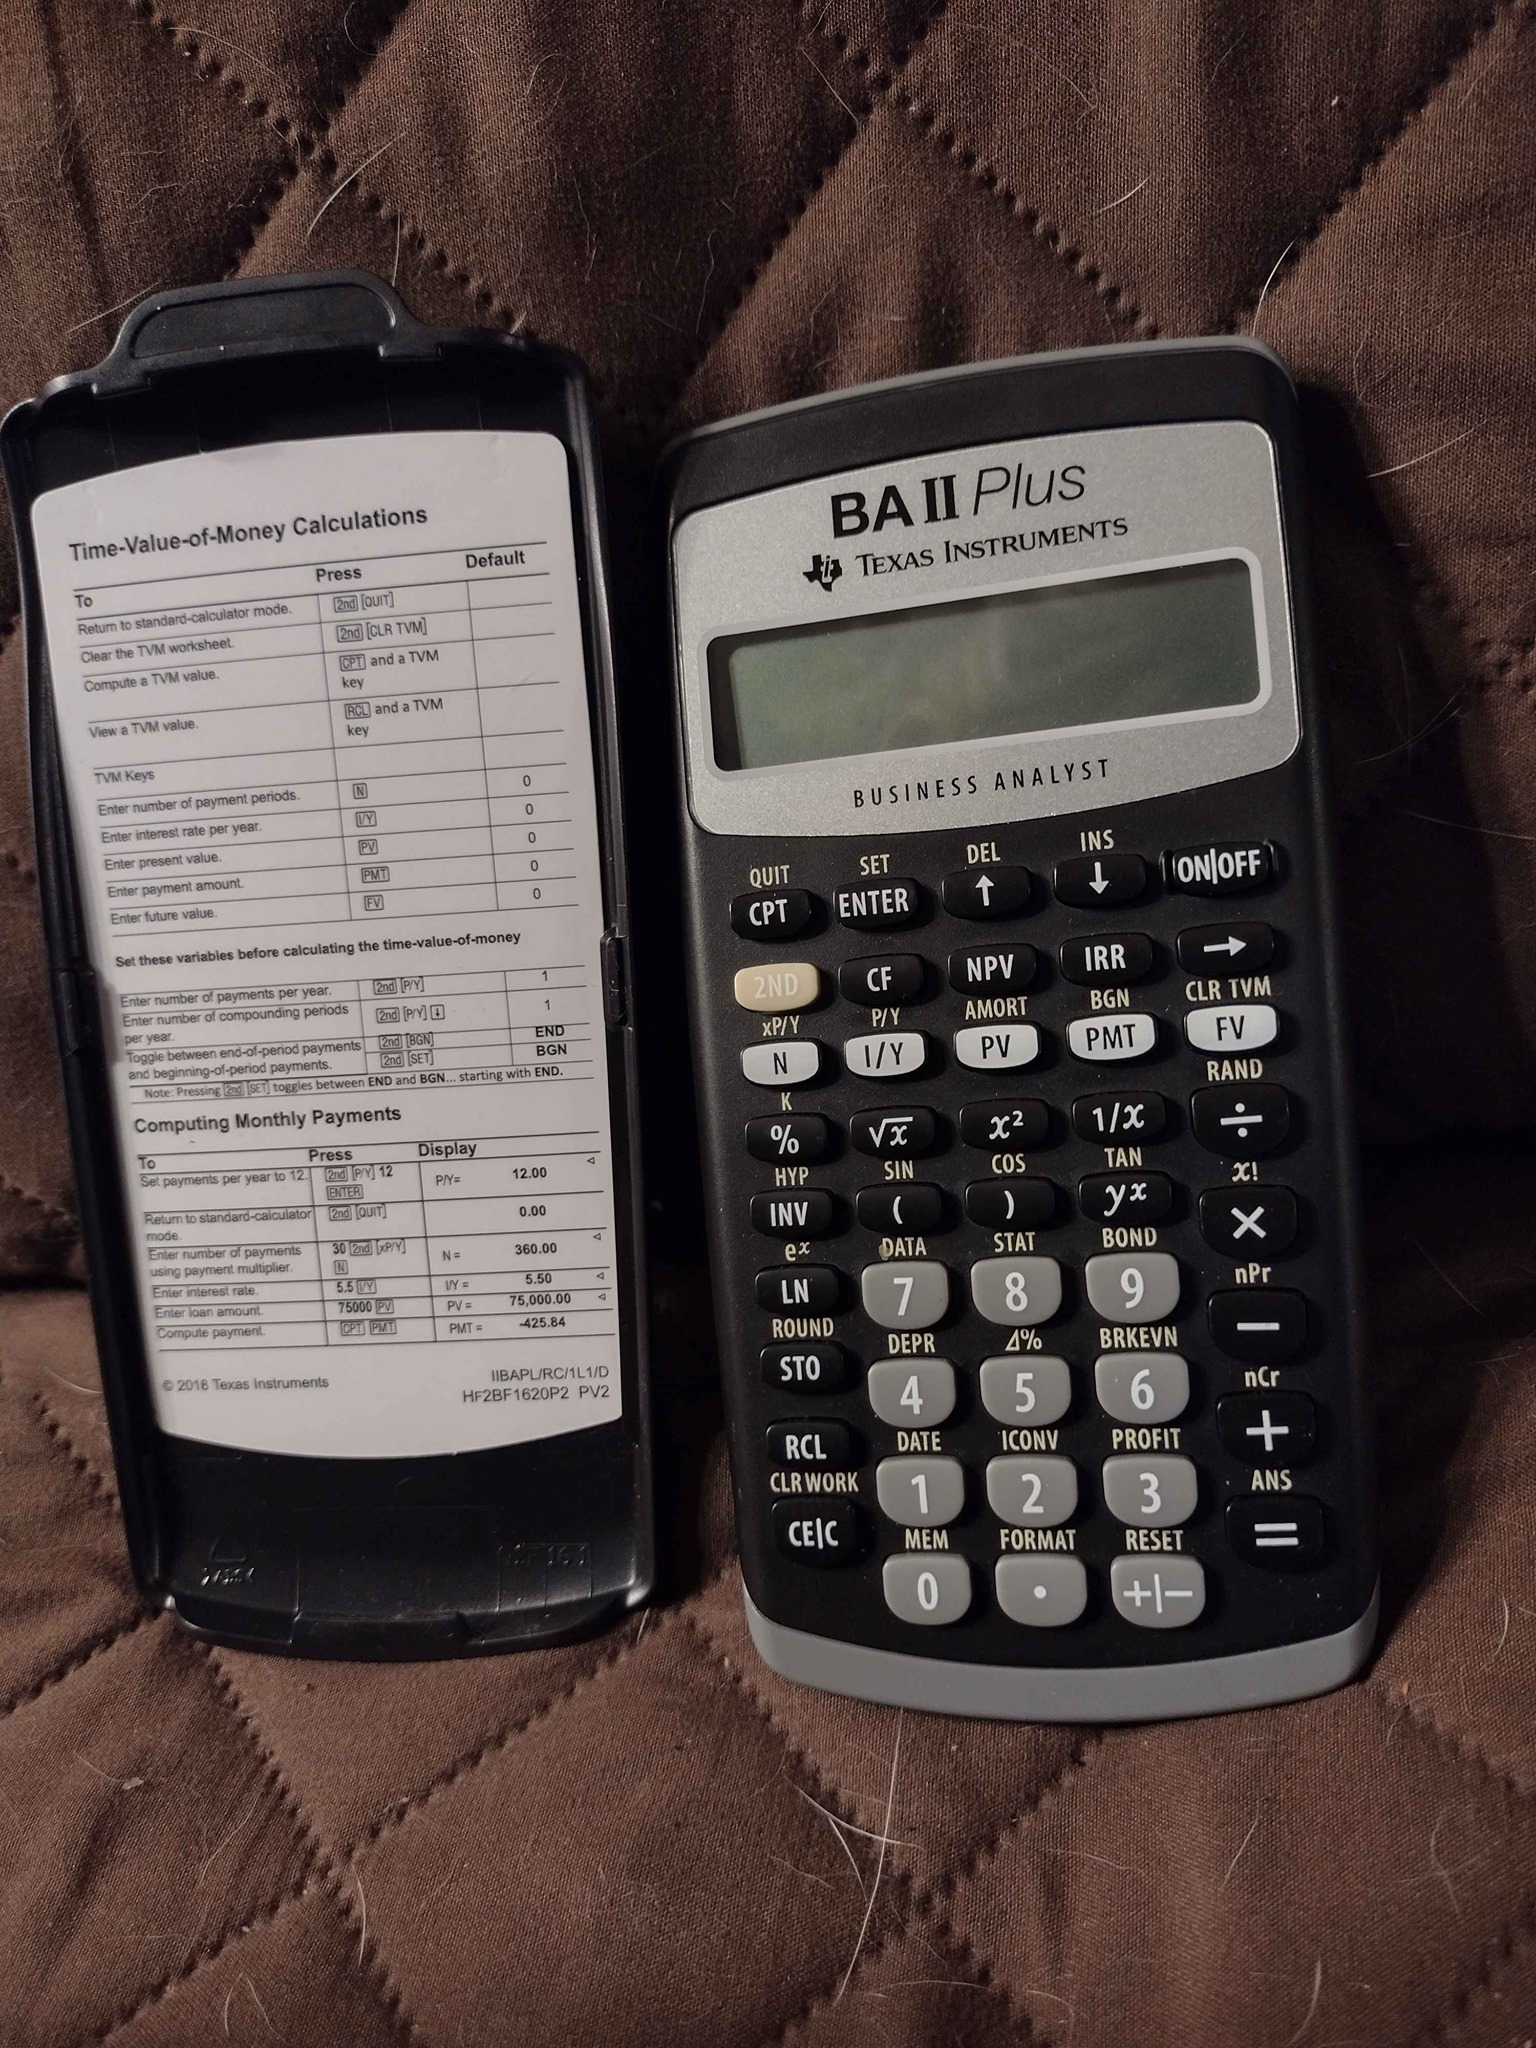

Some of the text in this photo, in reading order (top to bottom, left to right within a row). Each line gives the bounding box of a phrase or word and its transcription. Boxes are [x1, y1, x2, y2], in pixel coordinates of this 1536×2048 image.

[830, 462, 1086, 539] BA II Plus
[69, 508, 428, 562] Time-Value-of-Money Calculations
[465, 550, 526, 569] Default
[315, 567, 362, 583] Press
[74, 594, 93, 608] To
[78, 603, 292, 636] Return to standard-calculator mode.
[80, 638, 235, 664] Clear the TVM worksheet.
[84, 669, 220, 694] Compute a TVM value.
[89, 718, 199, 739] View a TVM value.
[94, 770, 155, 784] TVM Keys
[523, 774, 531, 787] 0
[853, 758, 1108, 808] BUSINESS ANALYST
[99, 790, 300, 816] Enter number of payment periods.
[525, 803, 534, 815] 0
[101, 821, 263, 844] Enter interest rate per year.
[528, 832, 536, 843] 0
[1080, 829, 1115, 851] INS
[104, 852, 222, 871] Enter present value.
[859, 853, 890, 875] SET
[967, 842, 1001, 864] DEL
[531, 860, 539, 872] 0
[750, 865, 790, 888] QUIT
[107, 878, 244, 898] Enter payment amount.
[533, 888, 541, 899] 0
[749, 899, 788, 926] CPT
[838, 887, 909, 918] ENTER
[111, 907, 217, 925] Enter future value.
[116, 931, 521, 968] Set these variables before calculating the time-value-of-money
[1085, 944, 1126, 971] IRR
[866, 966, 892, 992] CF
[966, 954, 1014, 982] NPV
[120, 985, 332, 1008] Enter number of payments per year.
[754, 973, 798, 999] 2ND
[1185, 975, 1272, 1002] CLR TVM
[965, 996, 1028, 1020] AMORT
[1090, 988, 1130, 1010] BGN
[762, 1015, 800, 1036] xP/Y
[872, 1007, 900, 1027] P/Y
[1216, 1015, 1245, 1041] FV
[535, 1025, 565, 1037] END
[1086, 1024, 1136, 1051] PMT
[536, 1044, 567, 1056] BGN
[864, 1042, 904, 1069] I/Y
[981, 1035, 1011, 1059] PV
[773, 1052, 788, 1075] N
[1207, 1058, 1263, 1082] RAND
[781, 1092, 793, 1111] K
[134, 1107, 402, 1136] Computing Monthly Payments
[309, 1148, 353, 1162] Press
[418, 1141, 477, 1158] Display
[1104, 1146, 1143, 1168] TAN
[138, 1156, 156, 1169] To
[512, 1167, 547, 1179] 12.00
[884, 1160, 914, 1180] SIN
[991, 1153, 1026, 1174] COS
[775, 1166, 809, 1186] HYP
[519, 1204, 547, 1217] 0.00
[770, 1201, 808, 1227] INV
[881, 1237, 927, 1258] DATA
[993, 1232, 1036, 1253] STAT
[1102, 1227, 1158, 1248] BOND
[514, 1243, 557, 1255] 360.00
[525, 1272, 552, 1285] 5.50
[1235, 1262, 1272, 1284] nPr
[781, 1278, 810, 1305] LN
[893, 1277, 914, 1316] 7
[1005, 1271, 1029, 1312] 8
[1120, 1267, 1145, 1309] 9
[338, 1301, 373, 1314] 75000
[510, 1292, 571, 1307] 75,000.00
[519, 1316, 566, 1329] -425.84
[772, 1317, 834, 1338] ROUND
[888, 1333, 936, 1354] DEPR
[1100, 1326, 1178, 1349] BRKEVN
[781, 1355, 821, 1381] STO
[1245, 1366, 1280, 1388] nCr
[213, 1376, 250, 1391] Texas
[254, 1375, 329, 1390] Instruments
[578, 1384, 610, 1399] PV2
[1015, 1372, 1036, 1414] 5
[1130, 1368, 1155, 1410] 6
[900, 1375, 923, 1414] 4
[785, 1434, 827, 1460] RCL
[897, 1430, 942, 1451] DATE
[1002, 1429, 1059, 1451] ICONV
[1112, 1428, 1181, 1449] PROFIT
[770, 1471, 859, 1493] CLR WORK
[1251, 1469, 1293, 1491] ANS
[911, 1474, 928, 1514] 1
[1021, 1473, 1044, 1514] 2
[1140, 1472, 1162, 1514] 3
[905, 1529, 949, 1550] MEM
[1000, 1528, 1076, 1550] FORMAT
[1126, 1530, 1183, 1551] RESET
[917, 1572, 939, 1611] 0
